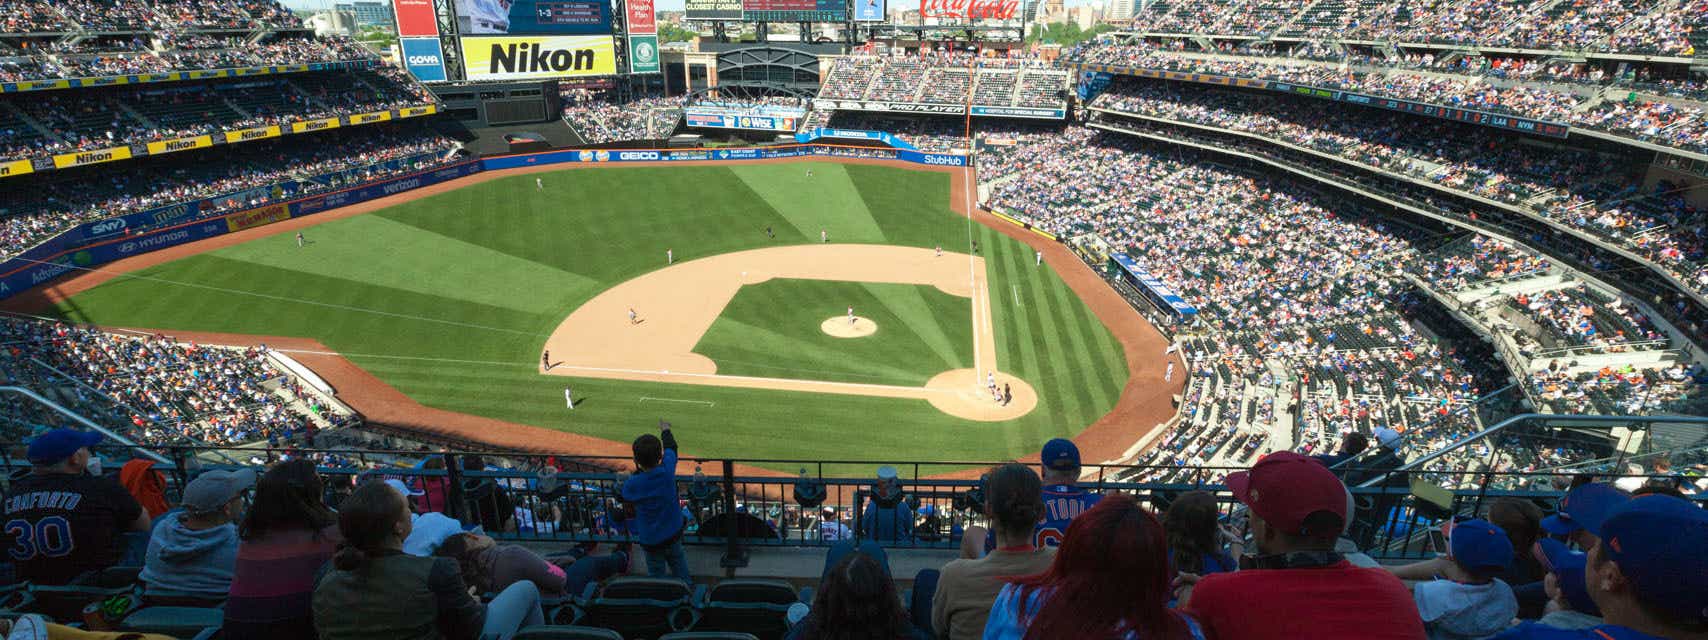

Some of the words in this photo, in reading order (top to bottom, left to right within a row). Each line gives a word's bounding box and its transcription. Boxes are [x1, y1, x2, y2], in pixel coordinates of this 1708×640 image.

[408, 55, 438, 65] GOYA
[489, 42, 595, 74] Nikon
[889, 103, 914, 111] PRO
[915, 105, 964, 113] PLAYER
[361, 114, 381, 122] Nikon
[306, 121, 328, 130] Nikon
[241, 129, 267, 140] Nikon
[165, 139, 196, 151] Nikon
[76, 151, 112, 164] Nikon
[620, 152, 658, 160] GEICO
[924, 155, 962, 166] StubHub
[383, 178, 419, 194] verizon
[92, 219, 121, 234] SNY
[139, 231, 189, 248] HYUNDAI
[4, 515, 74, 561] 30
